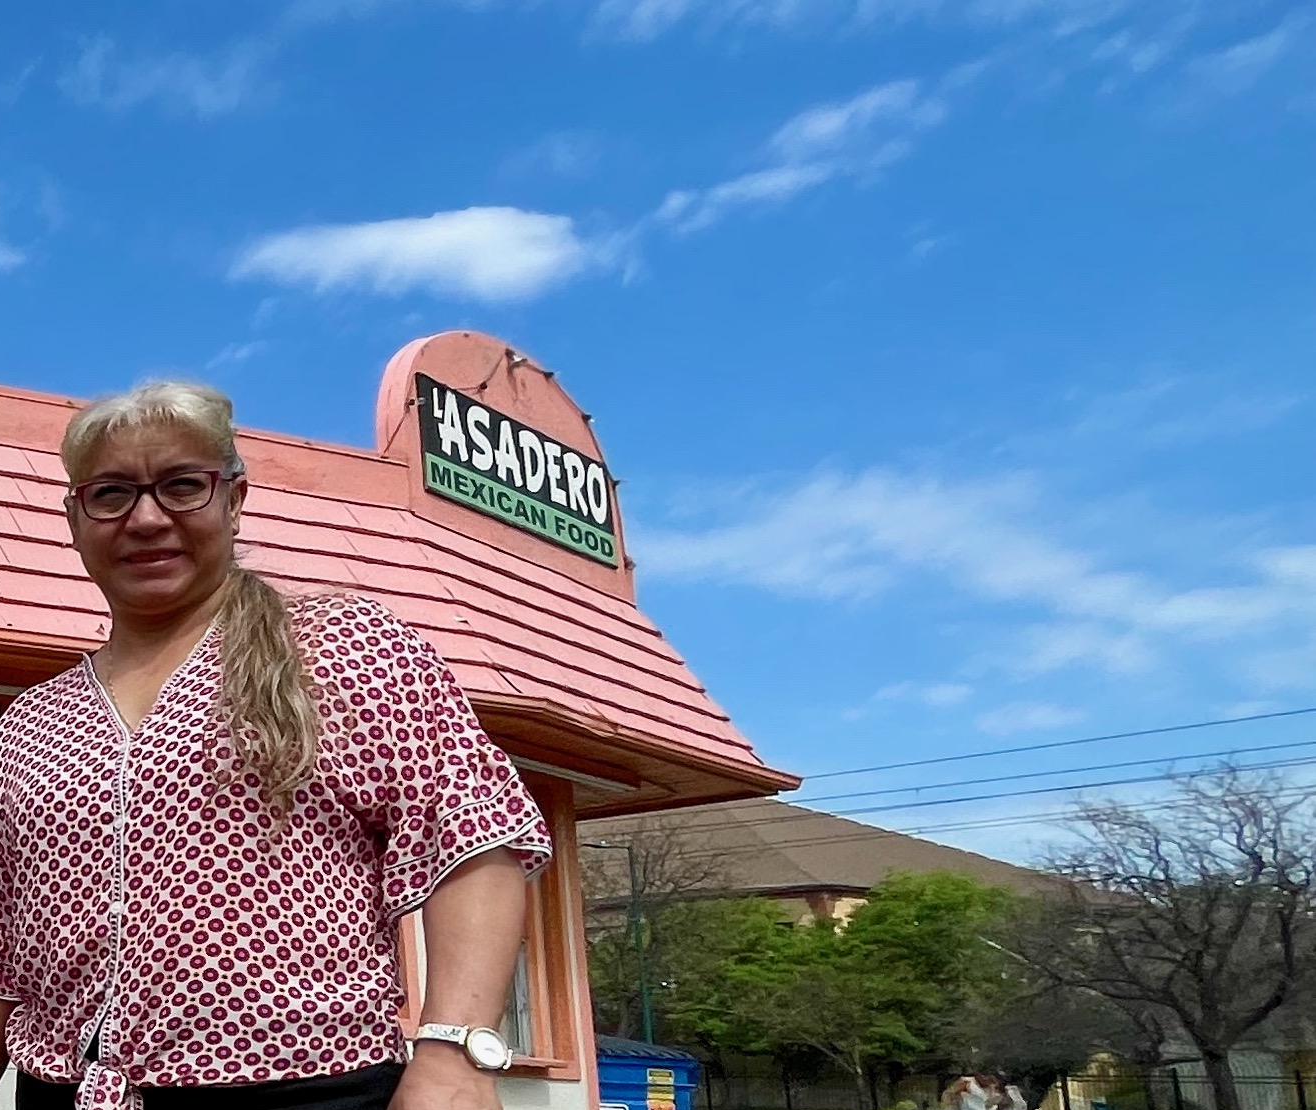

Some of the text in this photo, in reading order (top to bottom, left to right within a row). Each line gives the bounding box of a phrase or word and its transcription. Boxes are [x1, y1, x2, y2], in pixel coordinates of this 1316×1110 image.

[430, 462, 614, 559] MEXICAN FOOD
[438, 389, 609, 525] ASADERO
